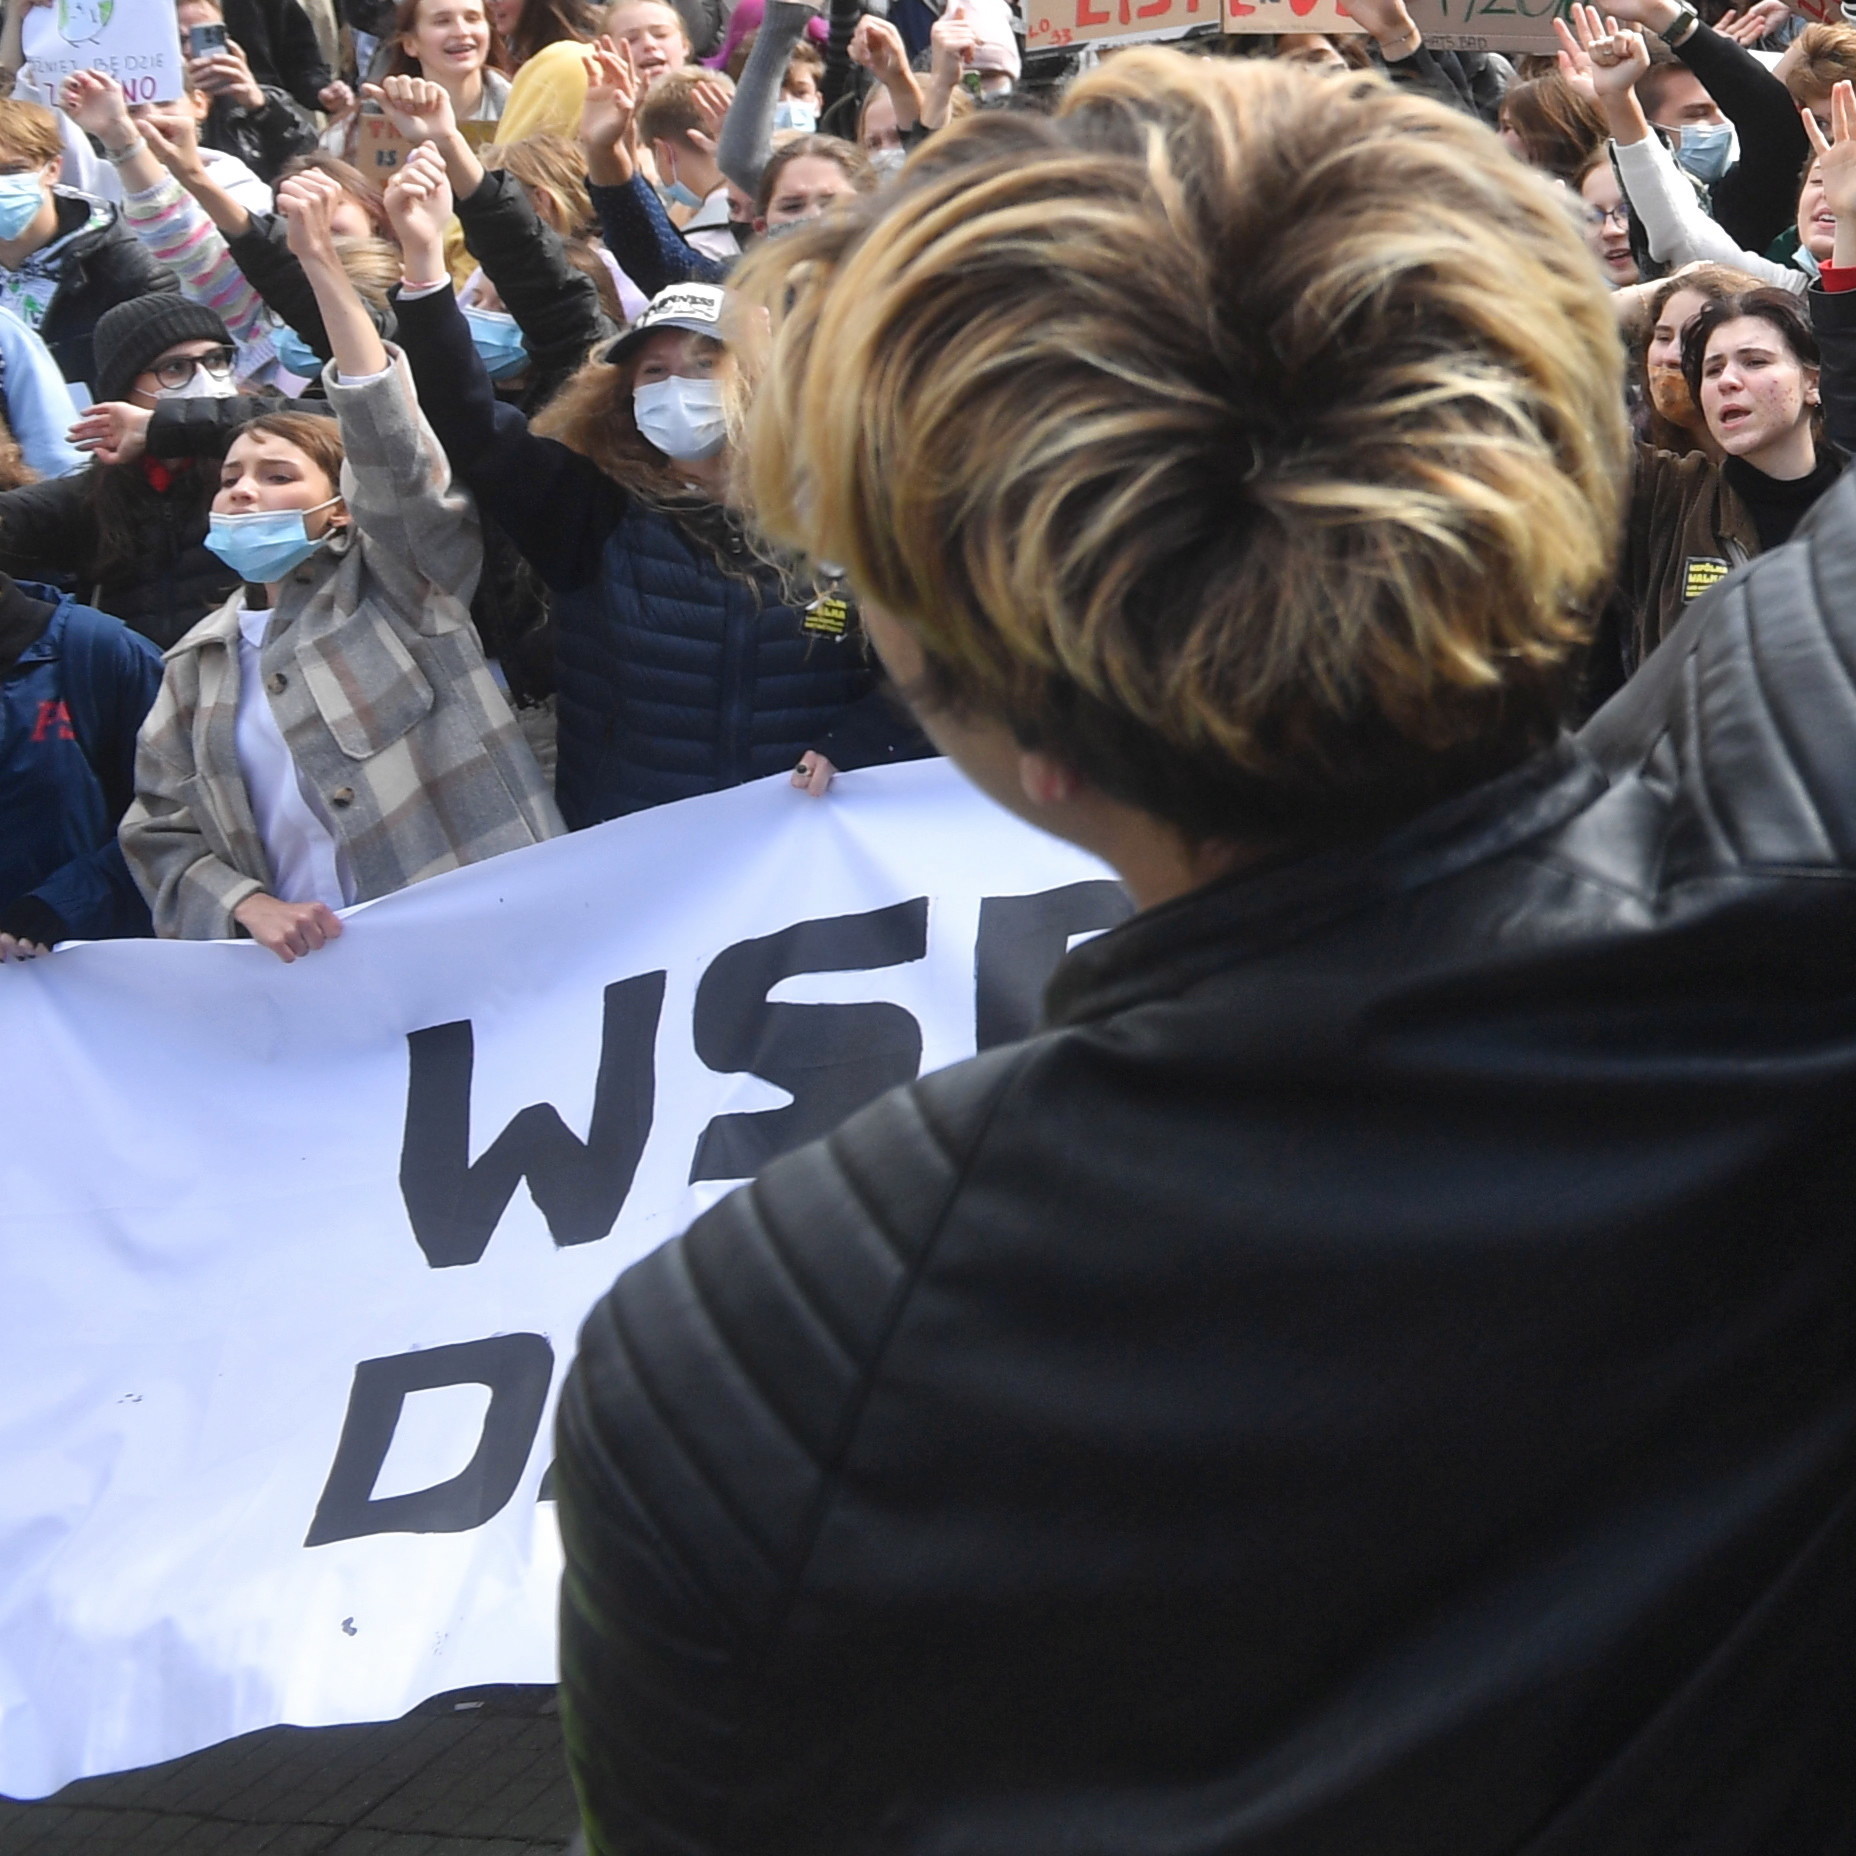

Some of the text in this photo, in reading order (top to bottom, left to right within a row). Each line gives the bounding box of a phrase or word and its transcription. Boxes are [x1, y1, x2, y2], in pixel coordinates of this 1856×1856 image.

[93, 53, 164, 76] BĘDZIE
[377, 150, 396, 166] IS
[305, 1332, 556, 1548] D
